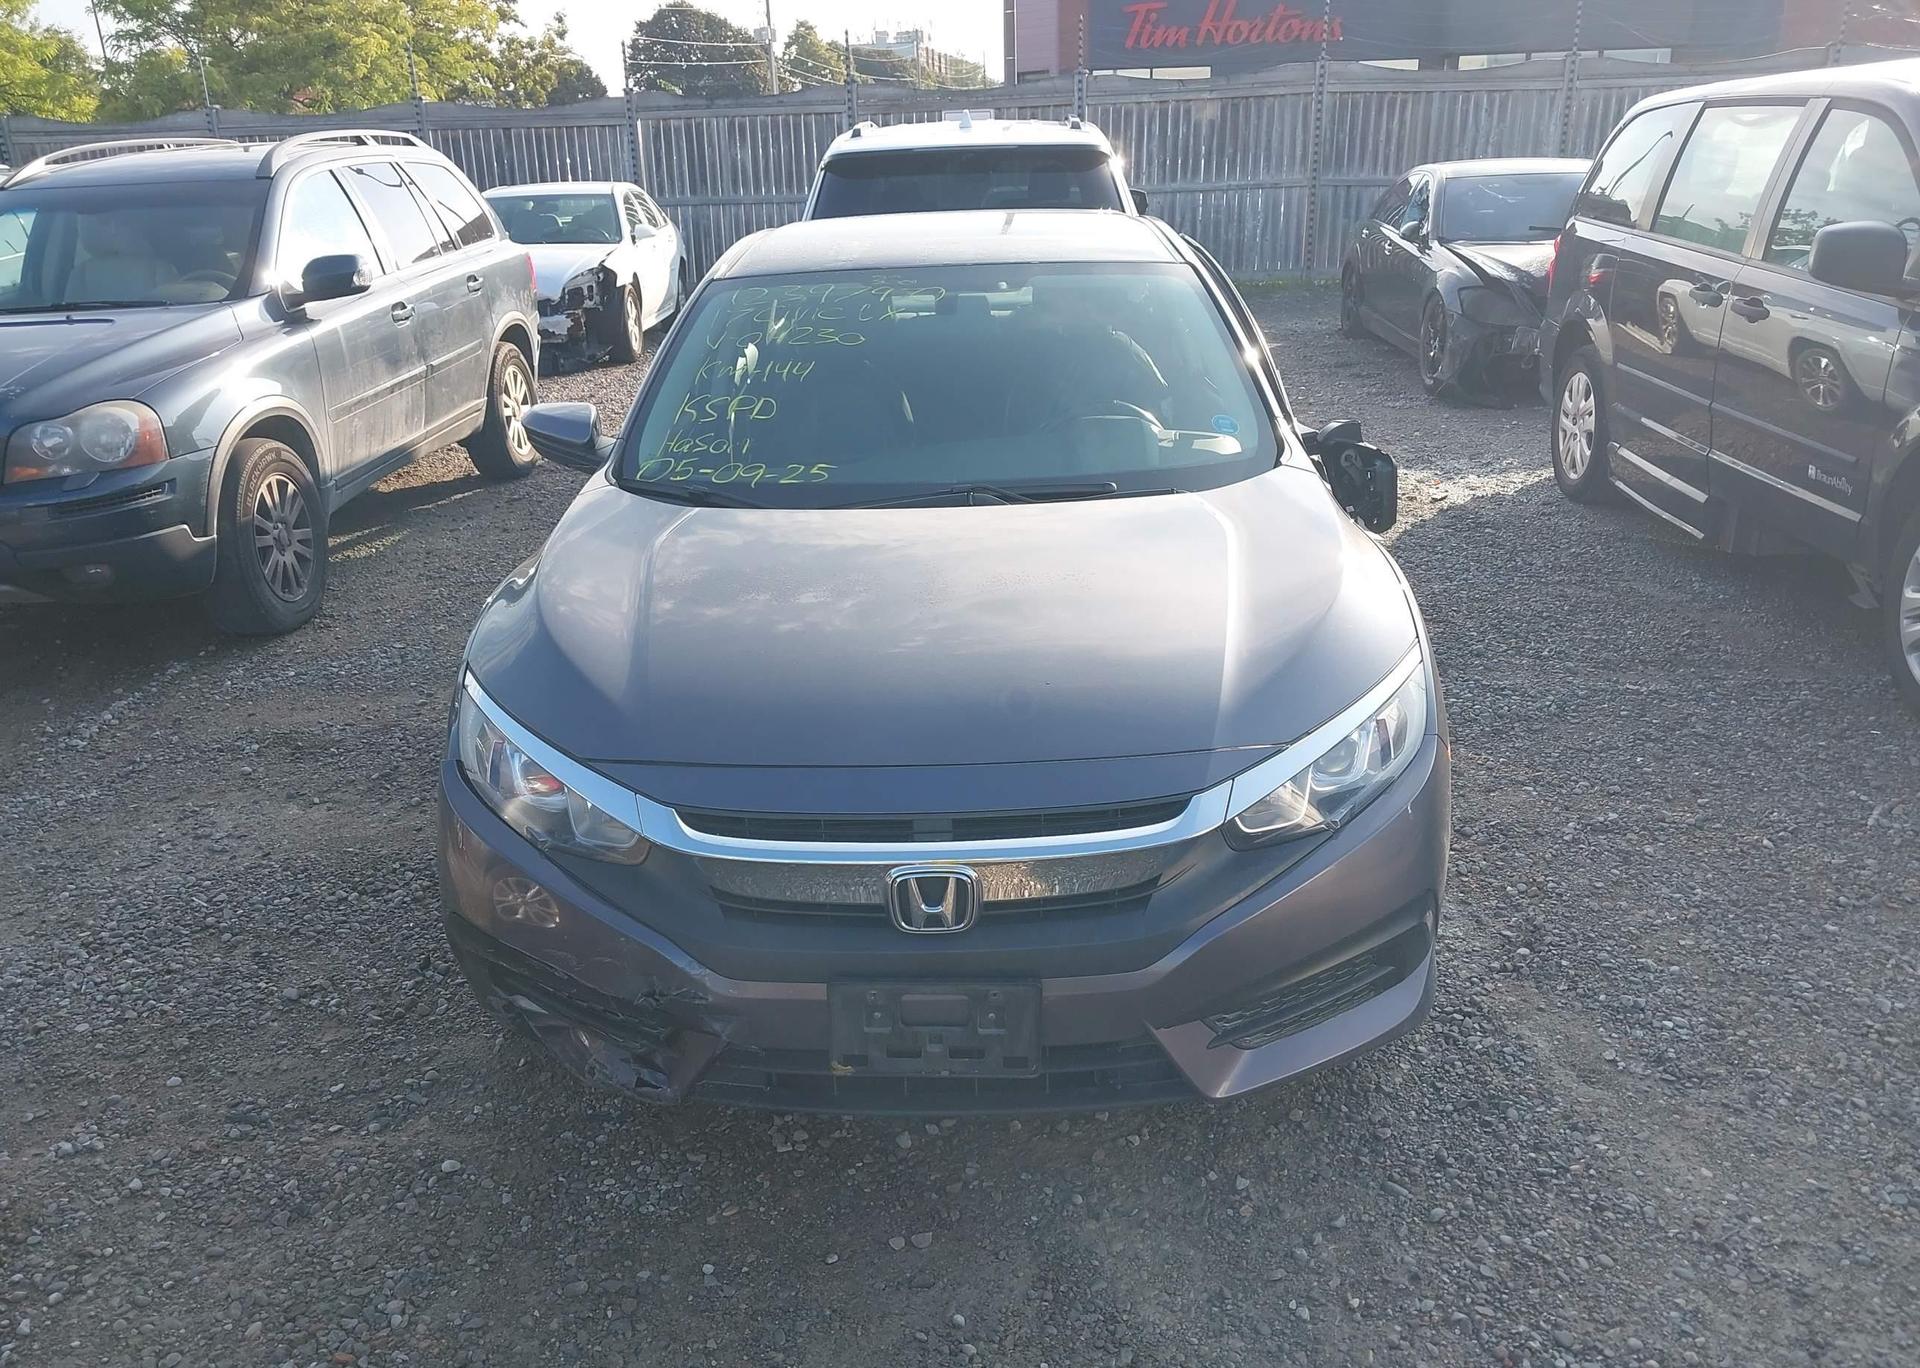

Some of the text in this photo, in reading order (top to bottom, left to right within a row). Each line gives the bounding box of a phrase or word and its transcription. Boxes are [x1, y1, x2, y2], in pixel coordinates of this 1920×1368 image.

[1122, 0, 1344, 49] Tim Hortons
[636, 458, 838, 488] 05-09-25
